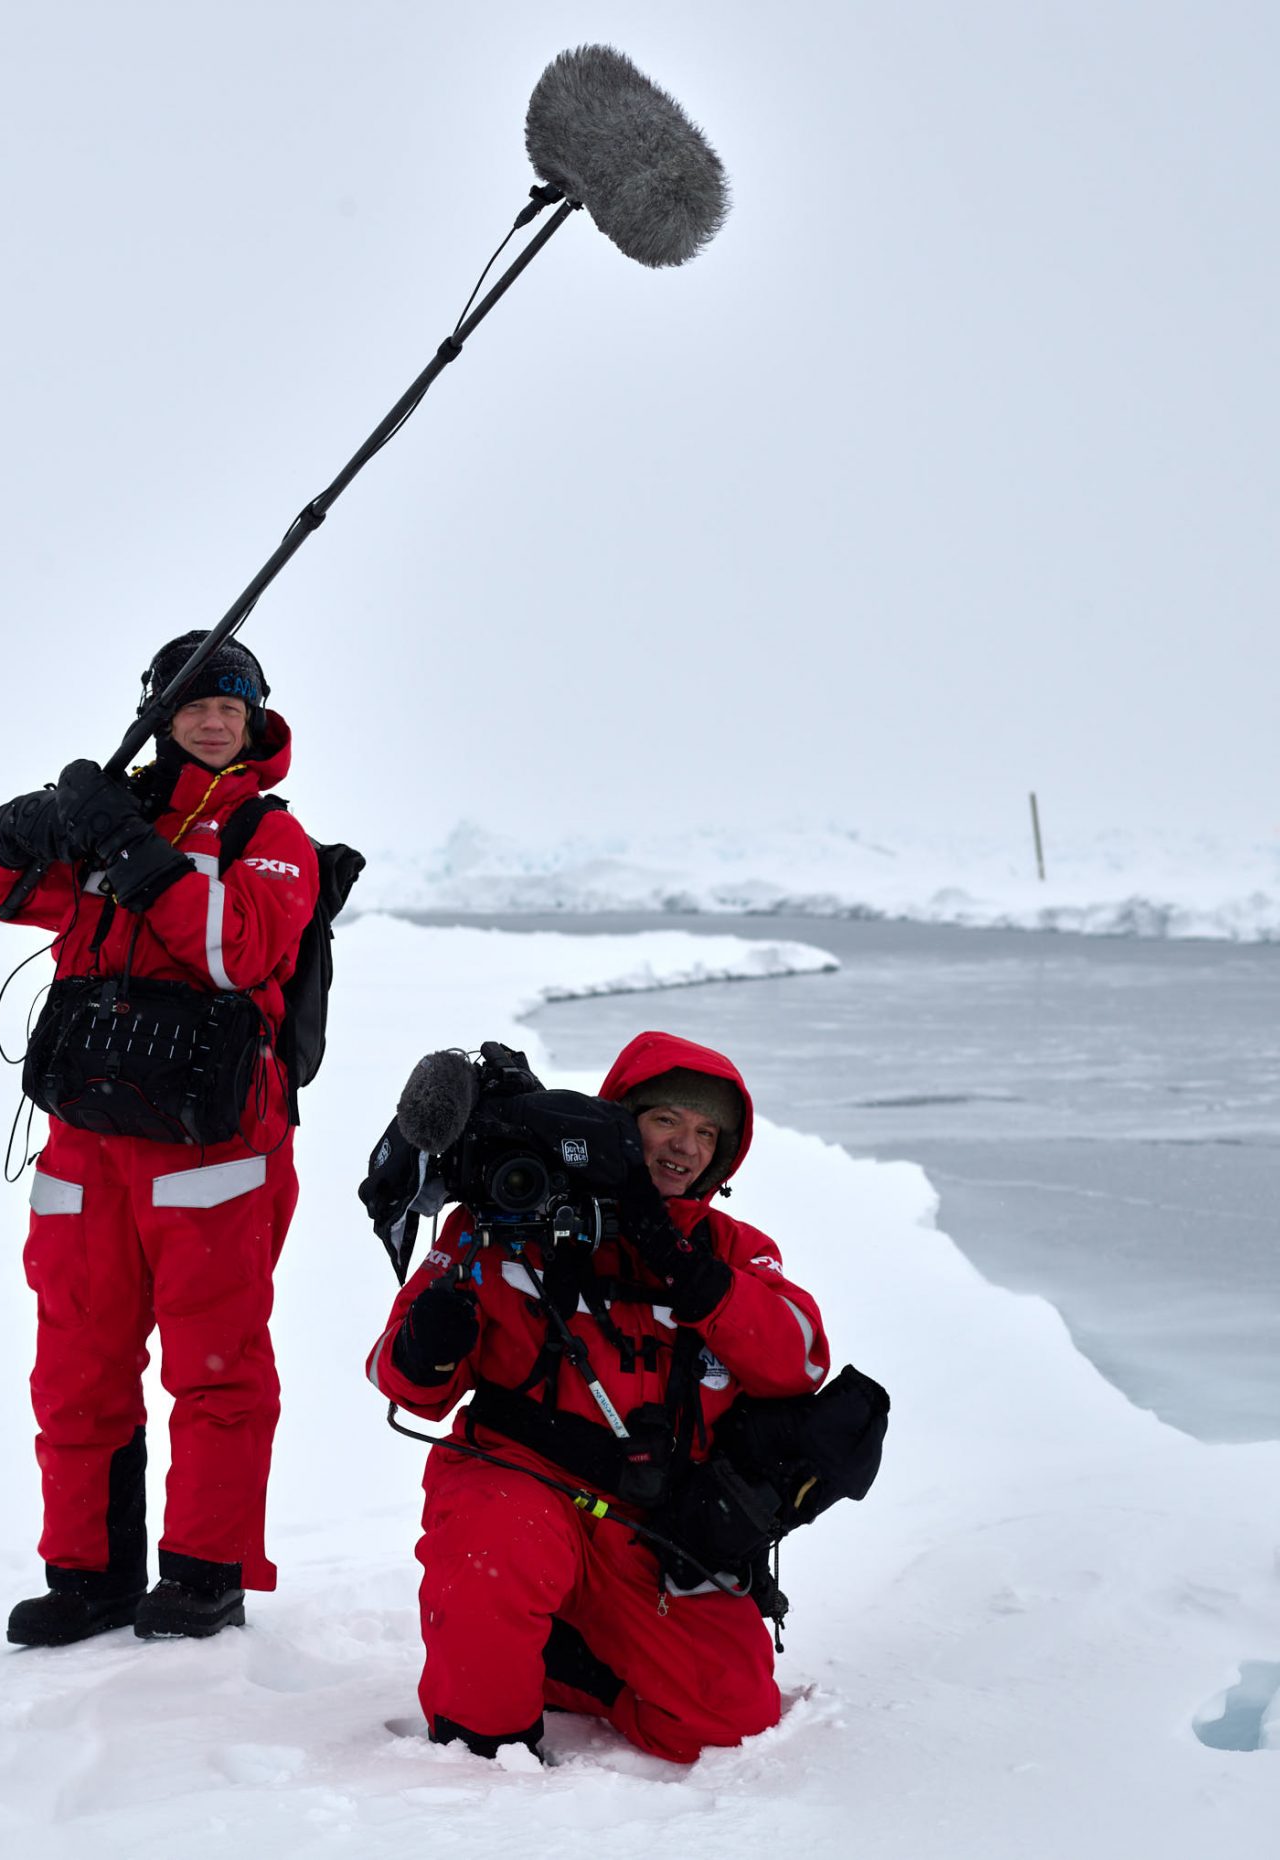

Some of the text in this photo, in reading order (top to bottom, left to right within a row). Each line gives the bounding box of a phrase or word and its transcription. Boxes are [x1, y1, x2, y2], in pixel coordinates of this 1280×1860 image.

[243, 857, 300, 878] FXR
[565, 1142, 585, 1154] porta
[565, 1153, 587, 1162] brace
